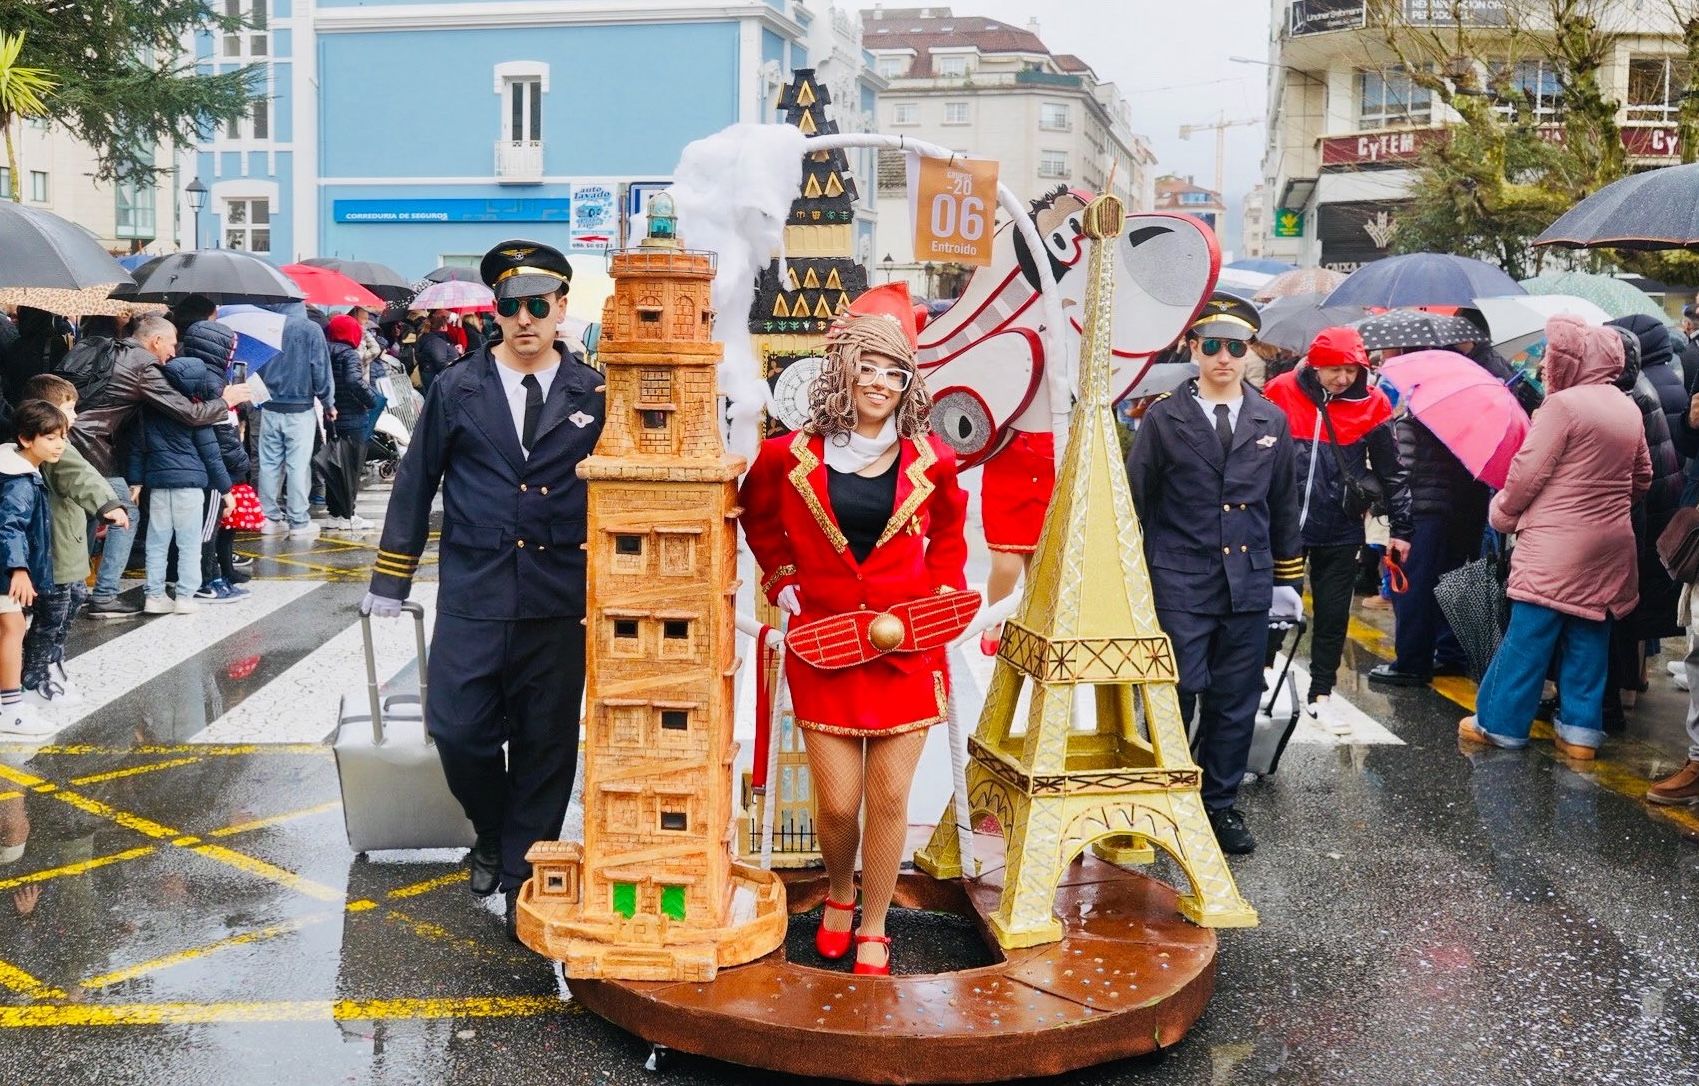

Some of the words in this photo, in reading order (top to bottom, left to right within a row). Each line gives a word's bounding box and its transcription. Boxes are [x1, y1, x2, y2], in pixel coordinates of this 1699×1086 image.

[931, 193, 984, 240] 06
[931, 240, 977, 255] Entroido
[1325, 262, 1358, 273] CAIXA
